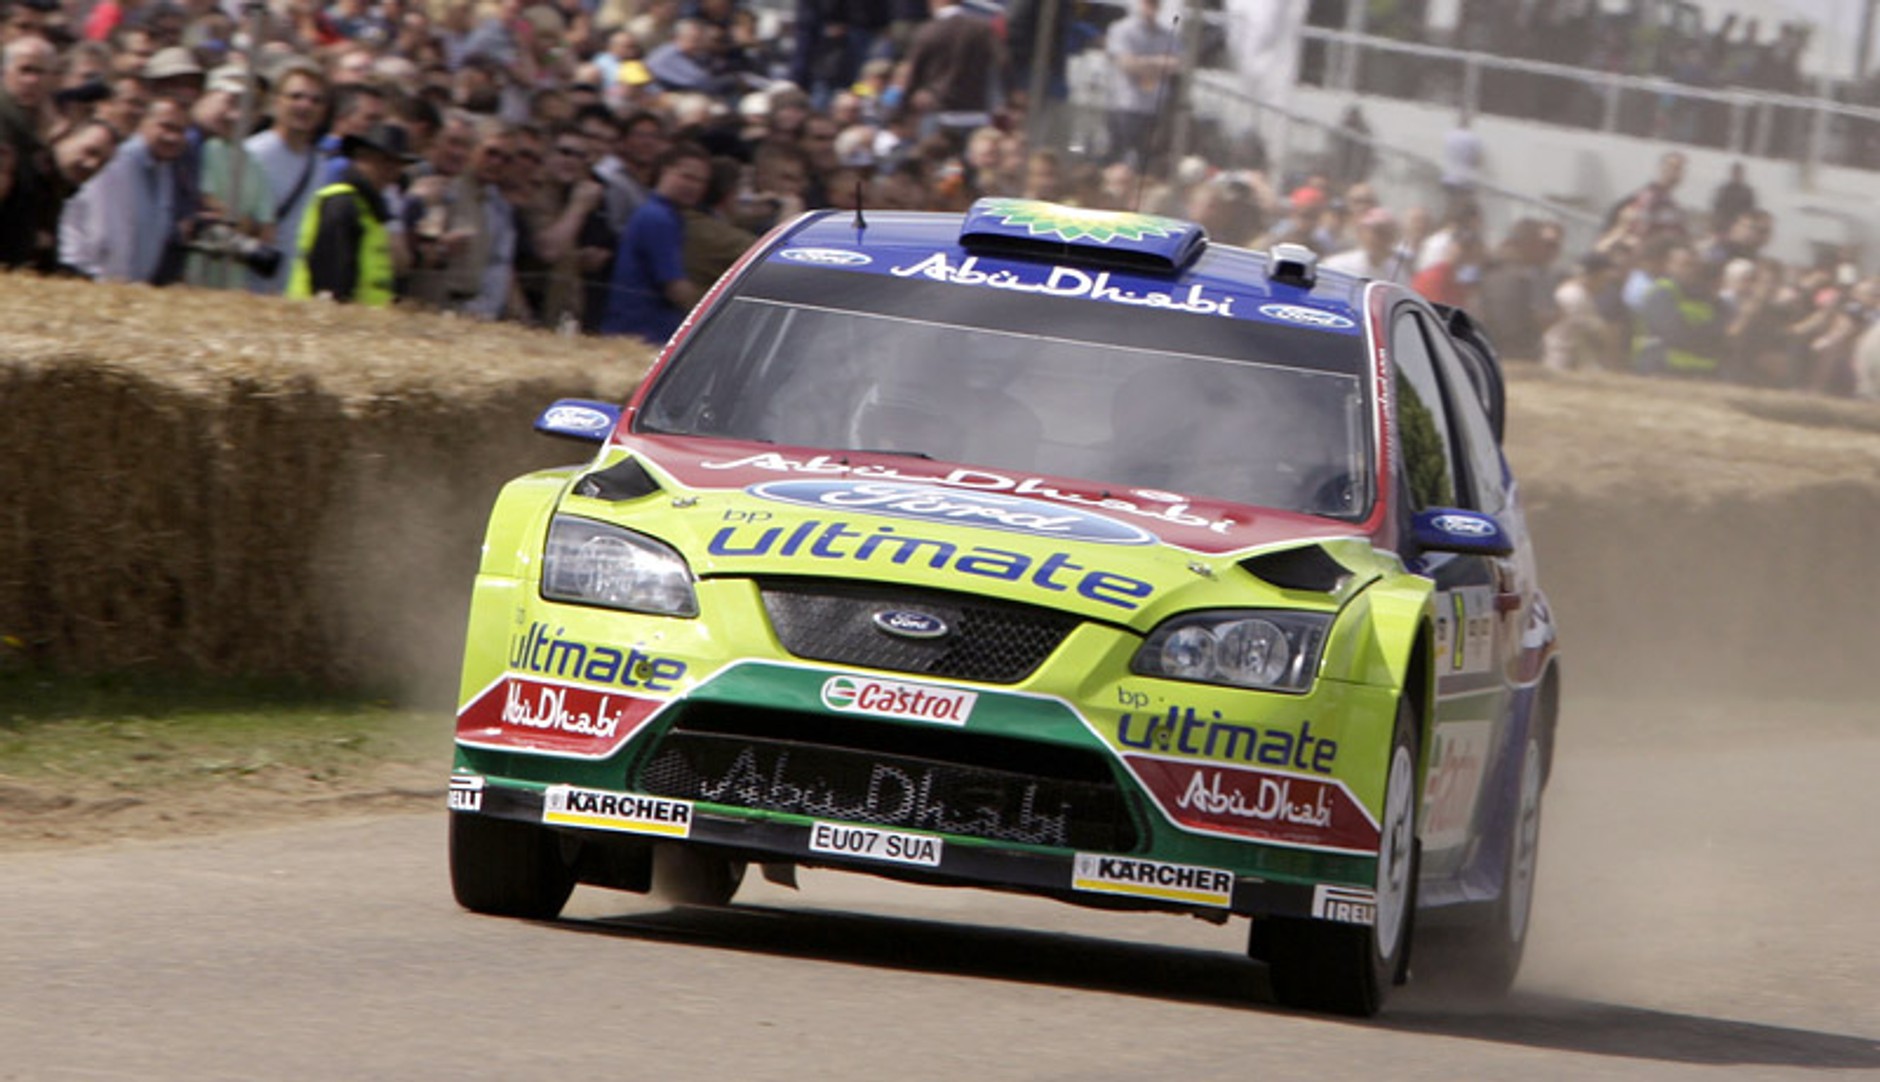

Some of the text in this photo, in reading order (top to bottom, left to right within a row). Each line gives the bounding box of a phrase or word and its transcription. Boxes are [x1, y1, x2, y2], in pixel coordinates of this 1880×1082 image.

[723, 510, 772, 523] bp
[820, 483, 1083, 531] Ford
[708, 520, 1154, 610] ultimate
[890, 613, 931, 630] Ford
[510, 621, 688, 692] ultimate
[857, 684, 965, 721] Castrol
[1117, 687, 1149, 708] bp
[1118, 705, 1338, 774] ultimate
[566, 790, 691, 823] KÄRCHER
[814, 825, 936, 862] EU07 SUA
[1098, 858, 1231, 893] KÄRCHER
